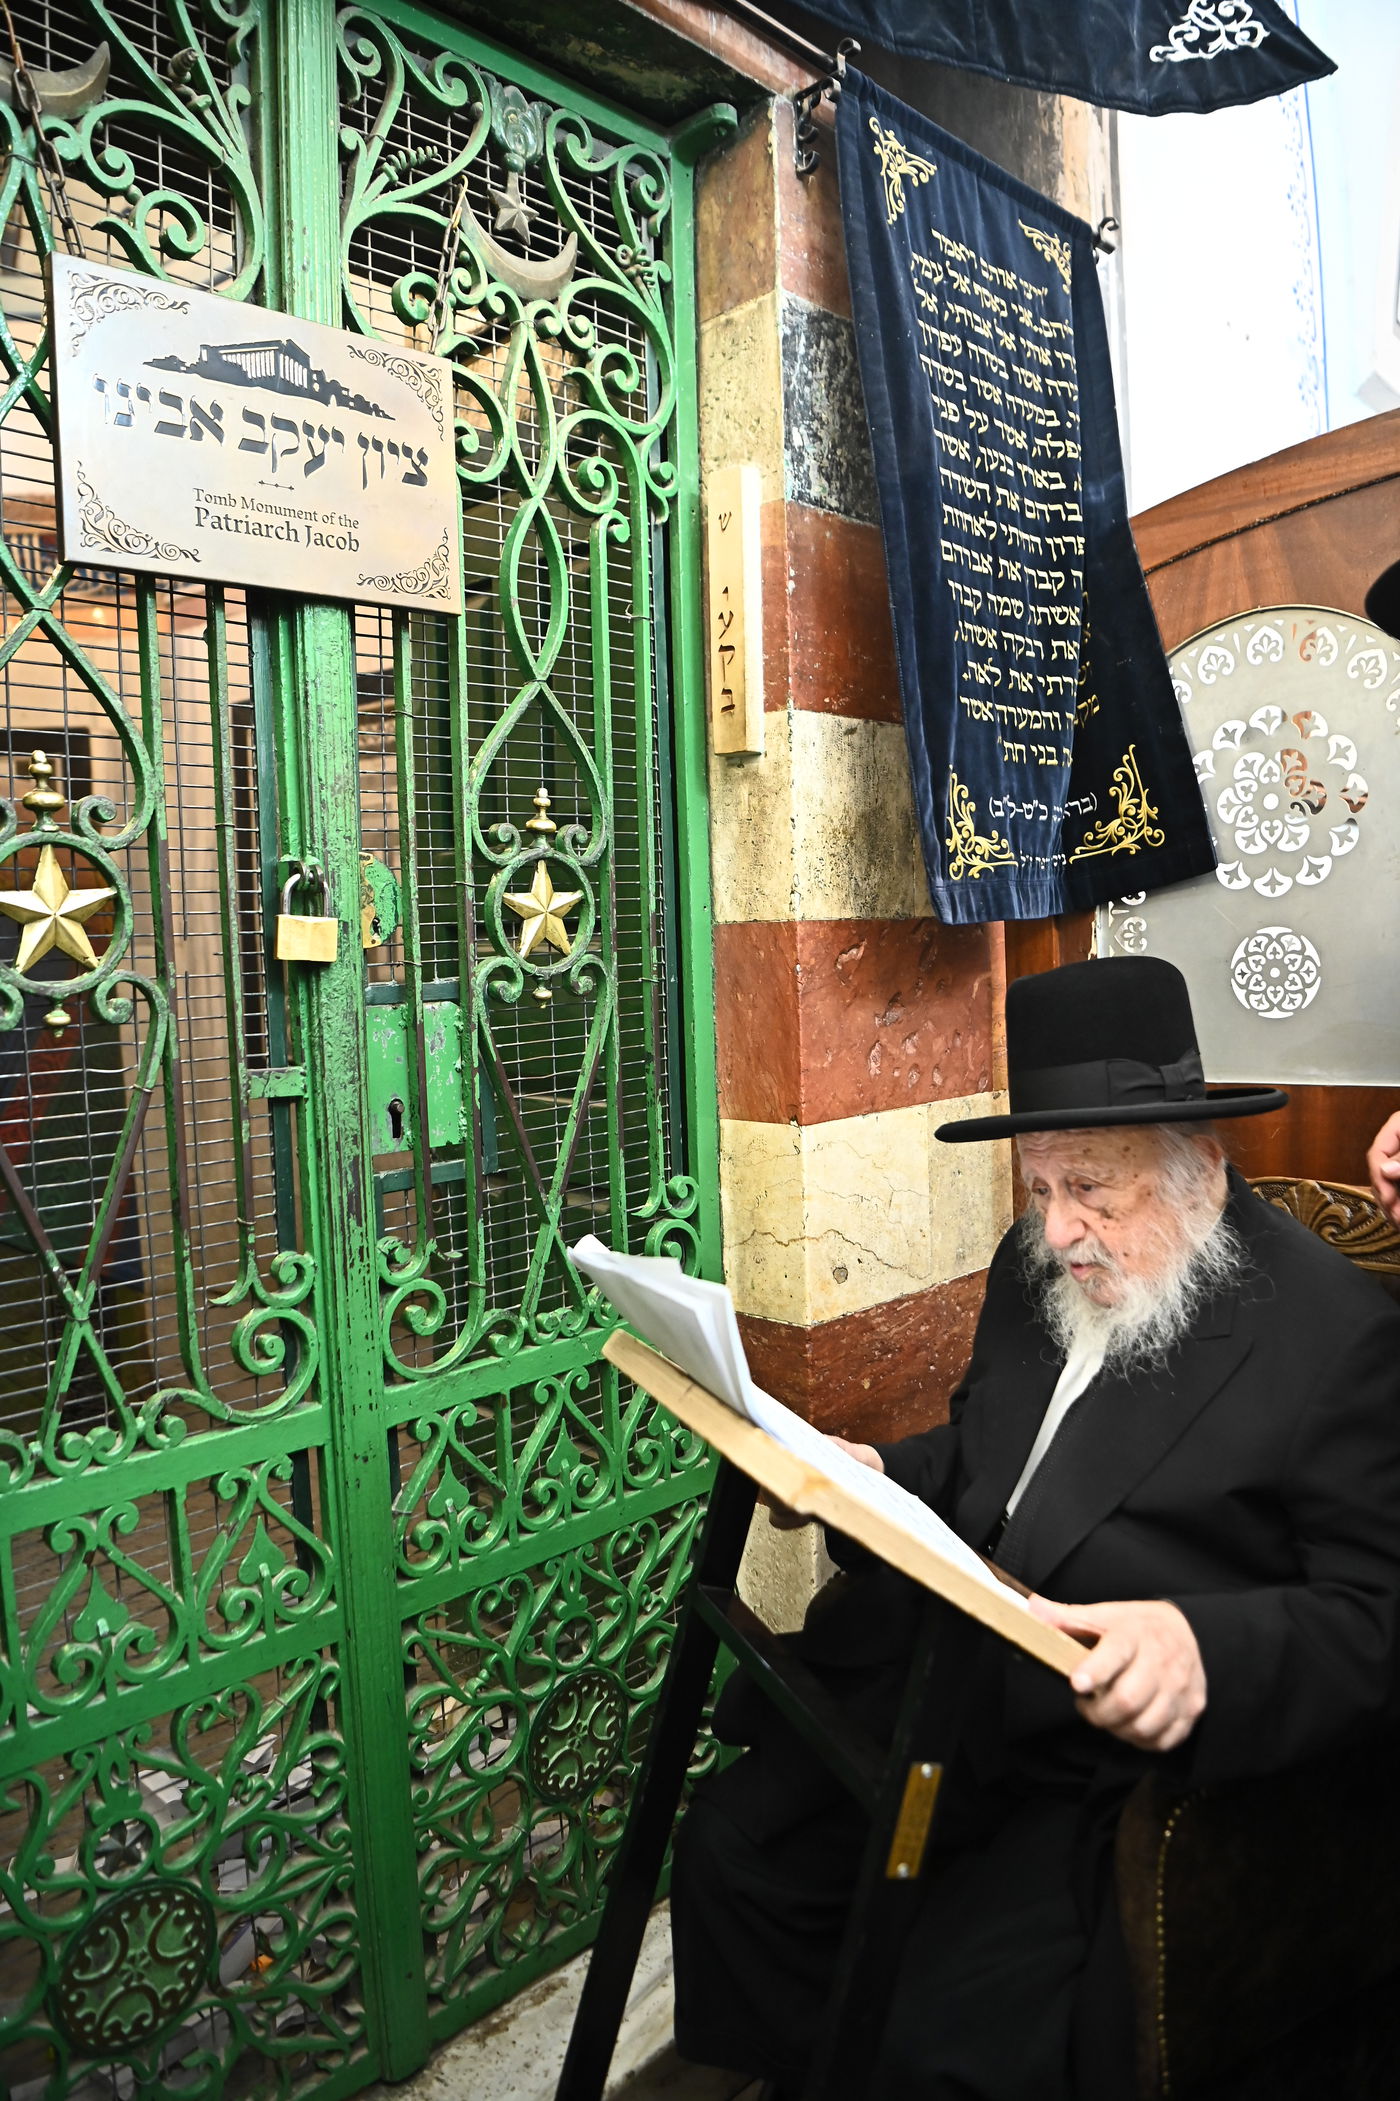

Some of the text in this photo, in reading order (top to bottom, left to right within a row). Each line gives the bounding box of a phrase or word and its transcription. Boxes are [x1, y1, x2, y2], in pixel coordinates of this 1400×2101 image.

[931, 228, 978, 269] ויאמר
[945, 260, 971, 295] אל
[913, 277, 939, 314] אל
[973, 281, 1009, 318] נאסף
[917, 318, 963, 357] עפרון
[993, 318, 1017, 352] אל
[919, 353, 968, 392] בשדה
[966, 340, 1010, 380] בשדה
[969, 374, 1003, 406] אשר
[1011, 363, 1044, 393] אשר
[931, 392, 961, 423] פני
[962, 399, 989, 434] על
[1004, 392, 1061, 428] במערה
[91, 373, 429, 490] ציון יעקב אבינו
[933, 427, 971, 462] אשר
[993, 417, 1028, 450] אשר
[1016, 461, 1067, 491] בארץ
[193, 486, 360, 530] Tomb Monument of the
[938, 466, 1084, 523] ברהם את השדה
[194, 506, 361, 553] Patriarch Jacob
[999, 522, 1043, 556] החתי
[940, 538, 993, 576] אברהם
[998, 556, 1022, 582] את
[947, 579, 983, 617] קברו
[986, 591, 1024, 620] שמה
[1001, 630, 1046, 661] רבקה
[961, 656, 1002, 687] לאה.
[1008, 667, 1034, 693] את
[959, 695, 995, 722] אשר
[995, 703, 1062, 731] והמערה
[1030, 743, 1058, 766] בני
